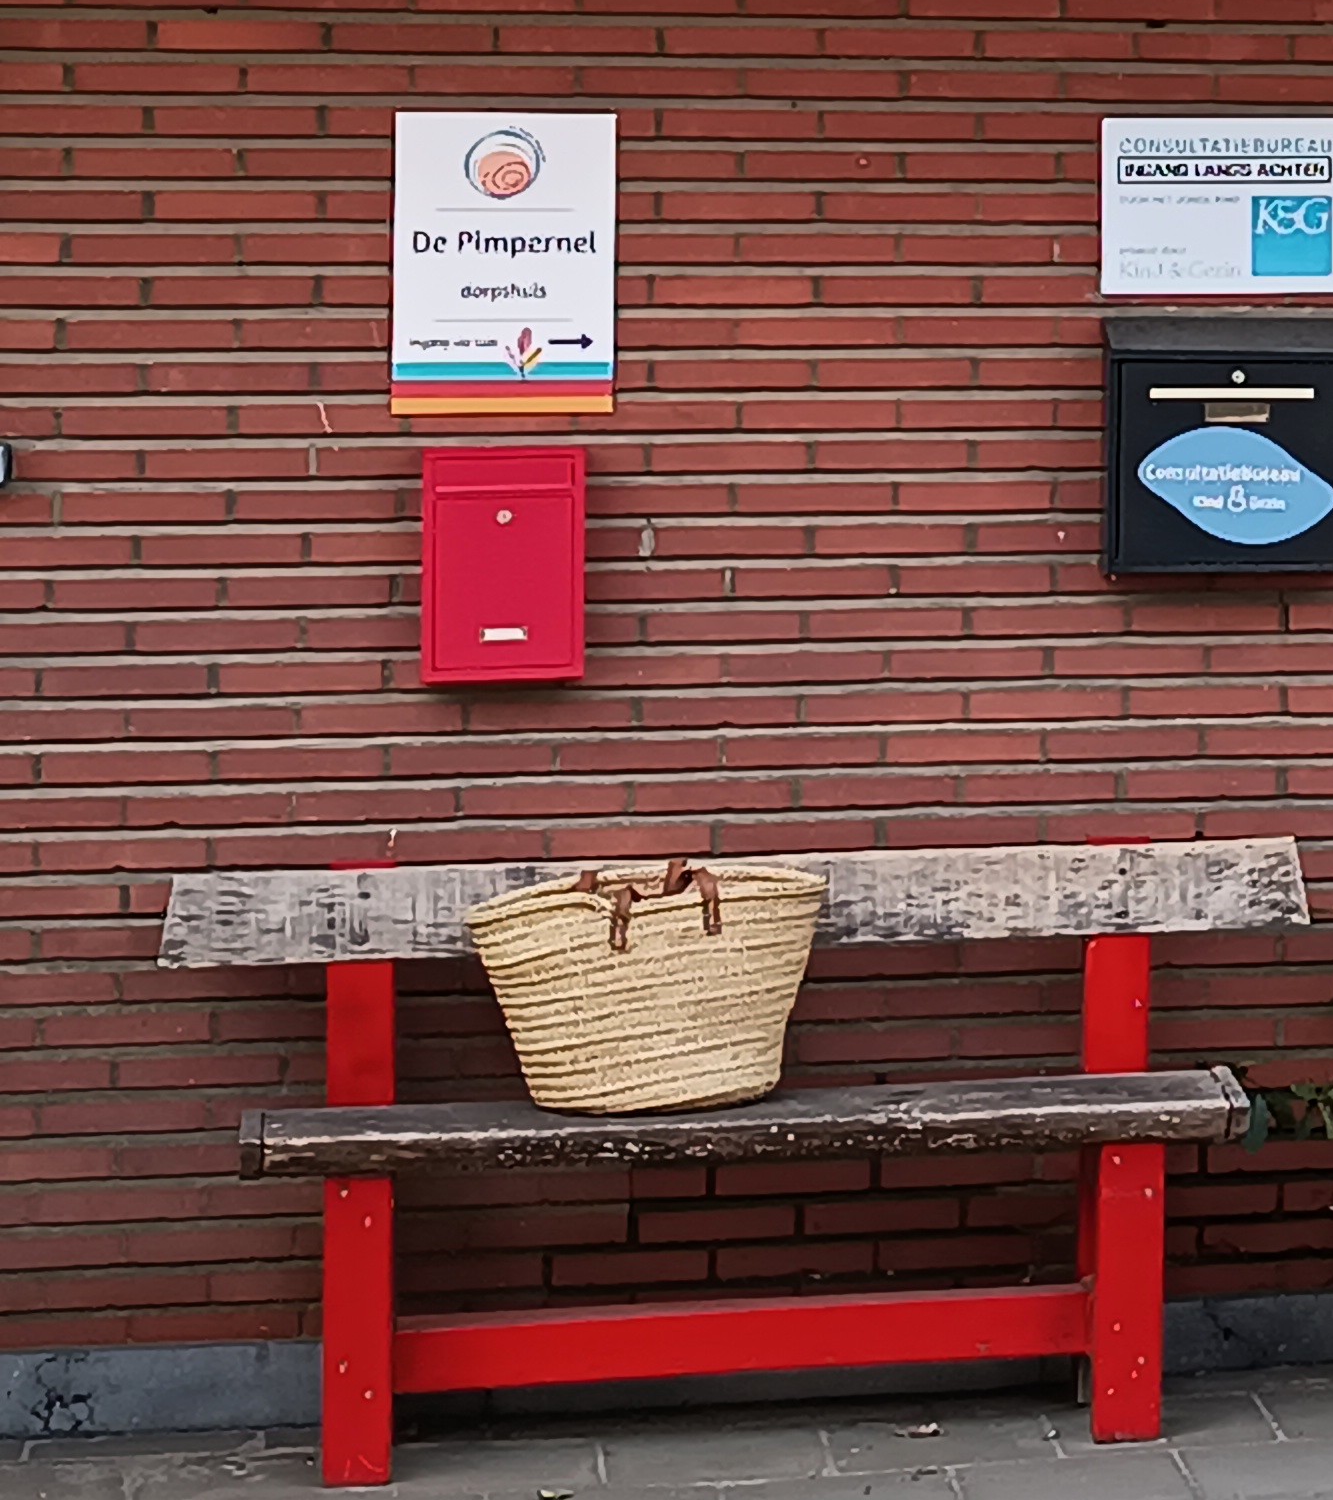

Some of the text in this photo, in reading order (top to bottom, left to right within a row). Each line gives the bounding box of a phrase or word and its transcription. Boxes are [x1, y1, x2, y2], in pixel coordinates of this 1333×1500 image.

[1118, 137, 1333, 154] CONSULTATIEBUREAU
[1194, 162, 1252, 177] LANGS
[412, 229, 597, 259] De Pimpernel
[460, 282, 547, 302] dorpshuis
